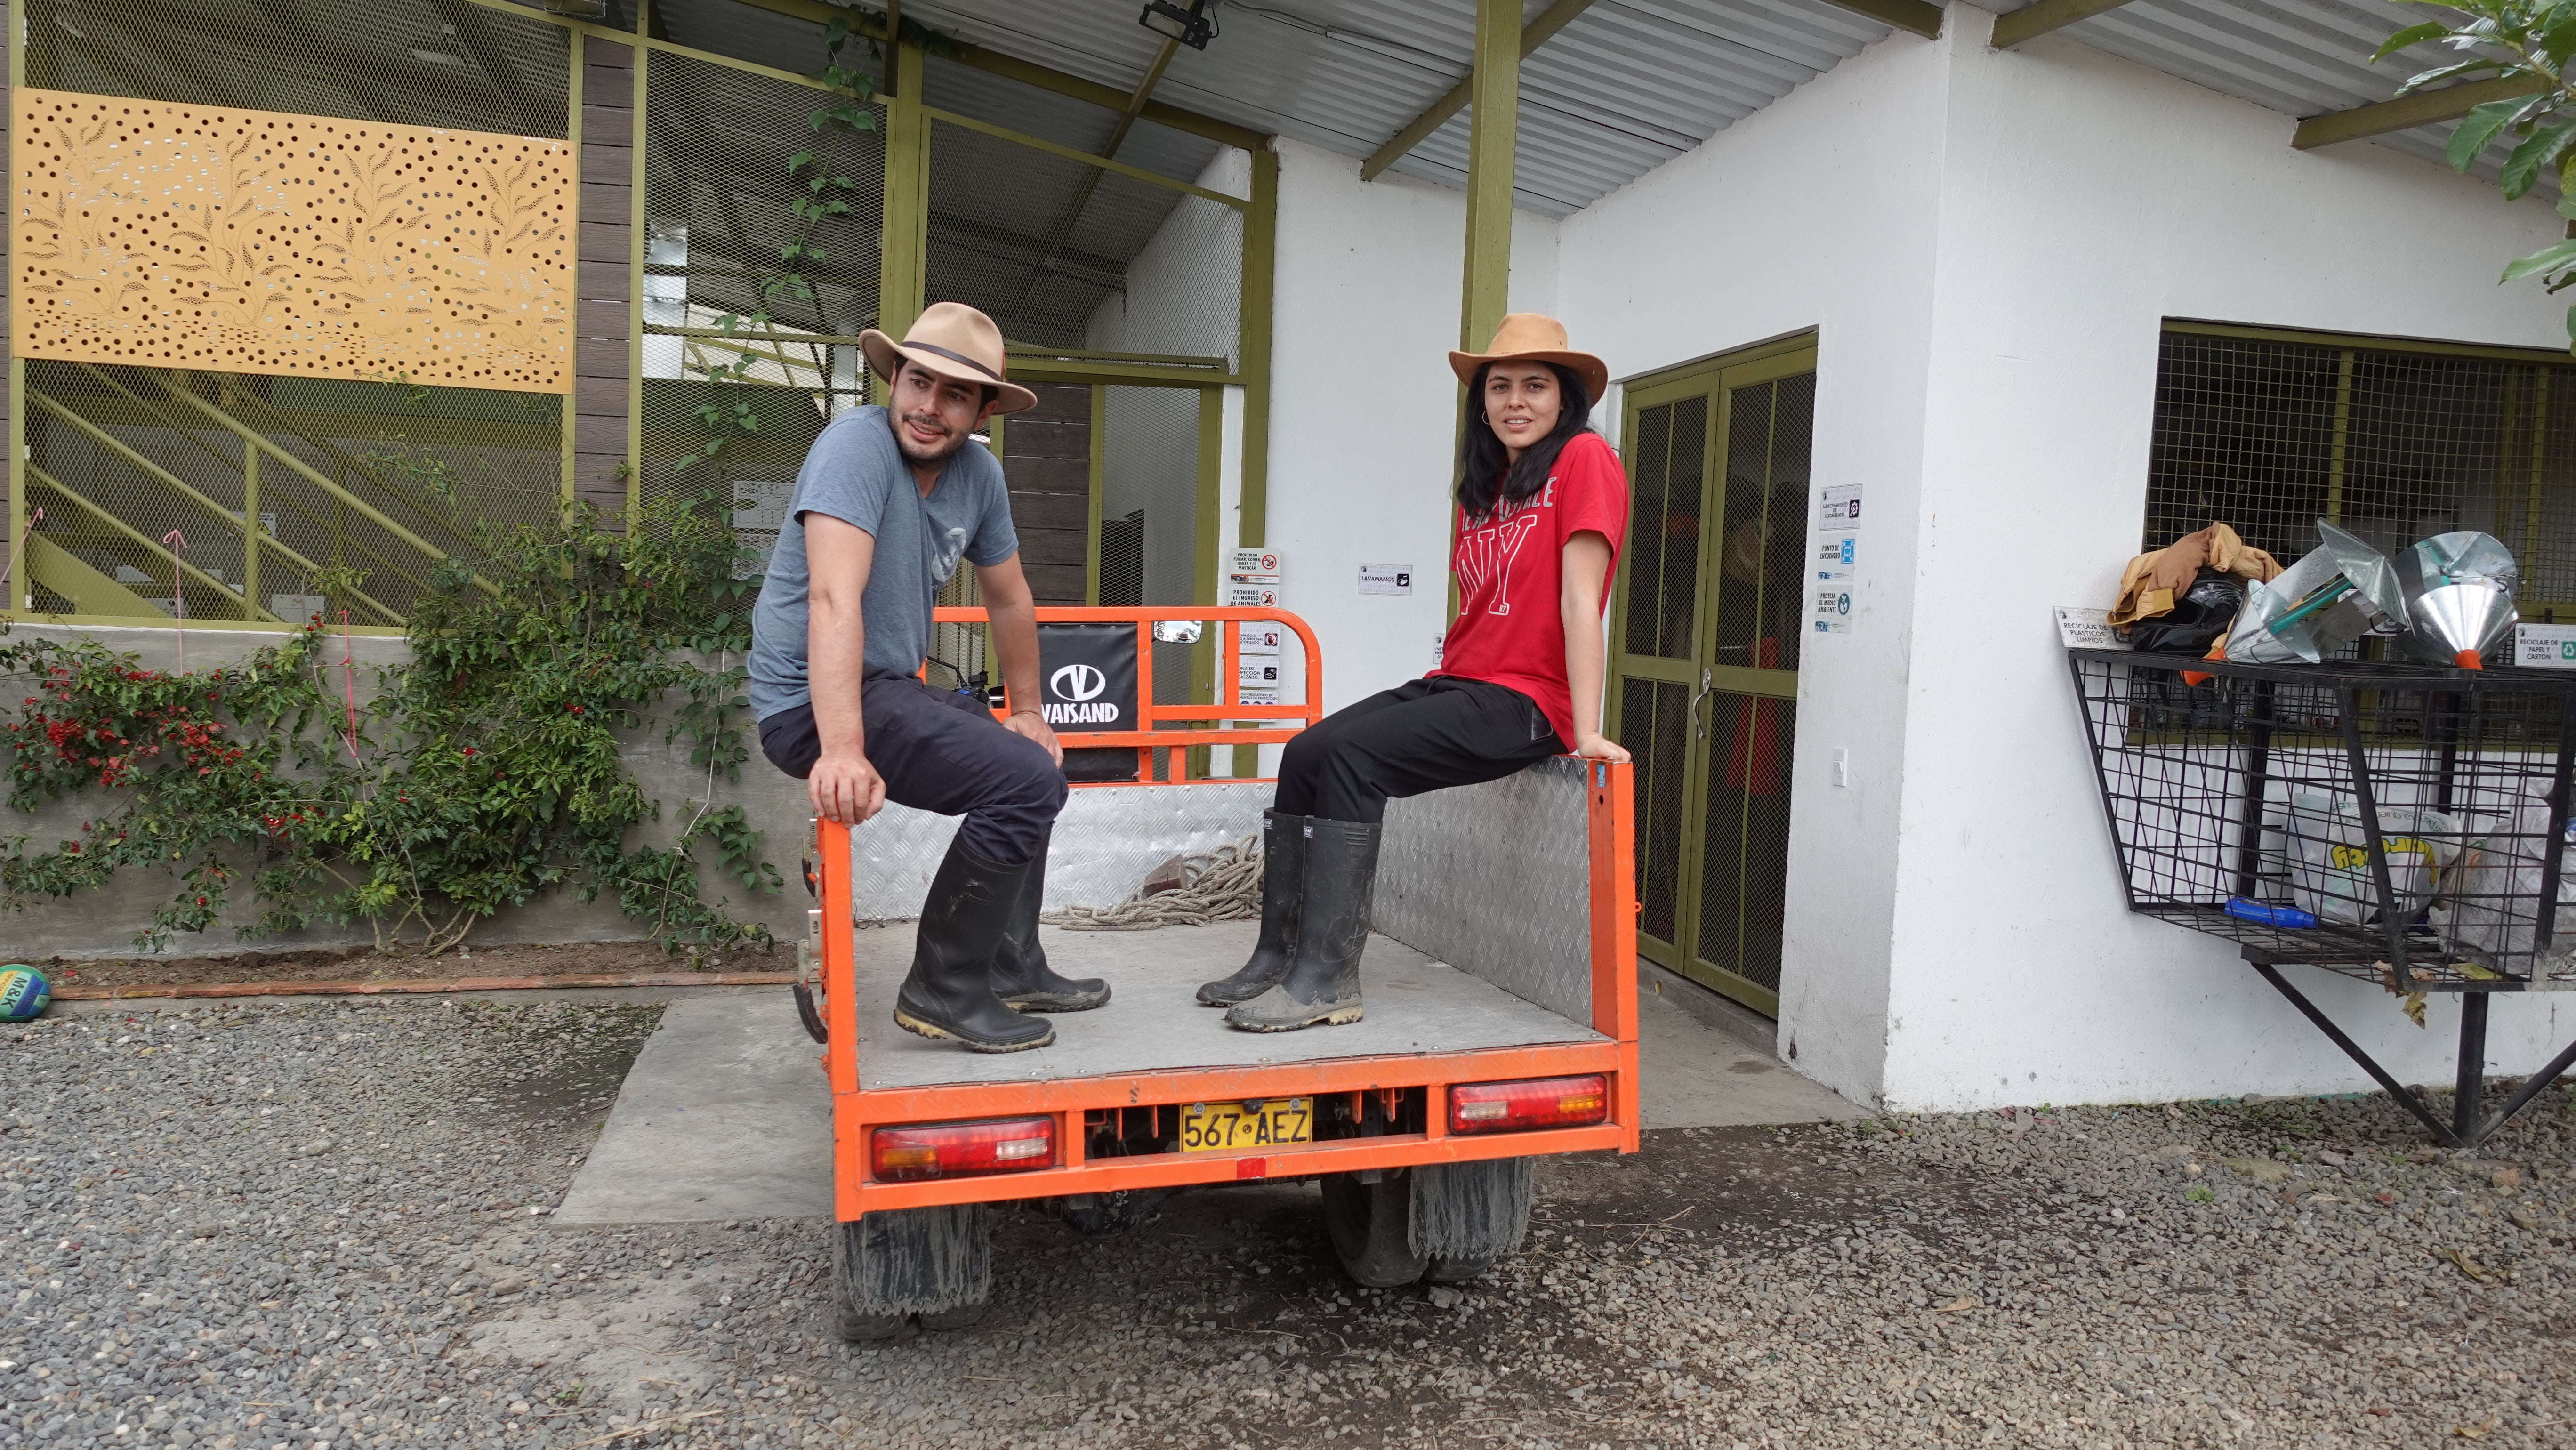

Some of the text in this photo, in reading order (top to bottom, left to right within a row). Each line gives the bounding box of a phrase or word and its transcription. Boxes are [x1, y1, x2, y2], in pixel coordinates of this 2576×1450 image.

[1499, 604, 1507, 612] 87
[1041, 703, 1119, 724] VAISAND
[1, 977, 28, 1008] M&K
[1185, 1109, 1308, 1147] 567 AEZ
